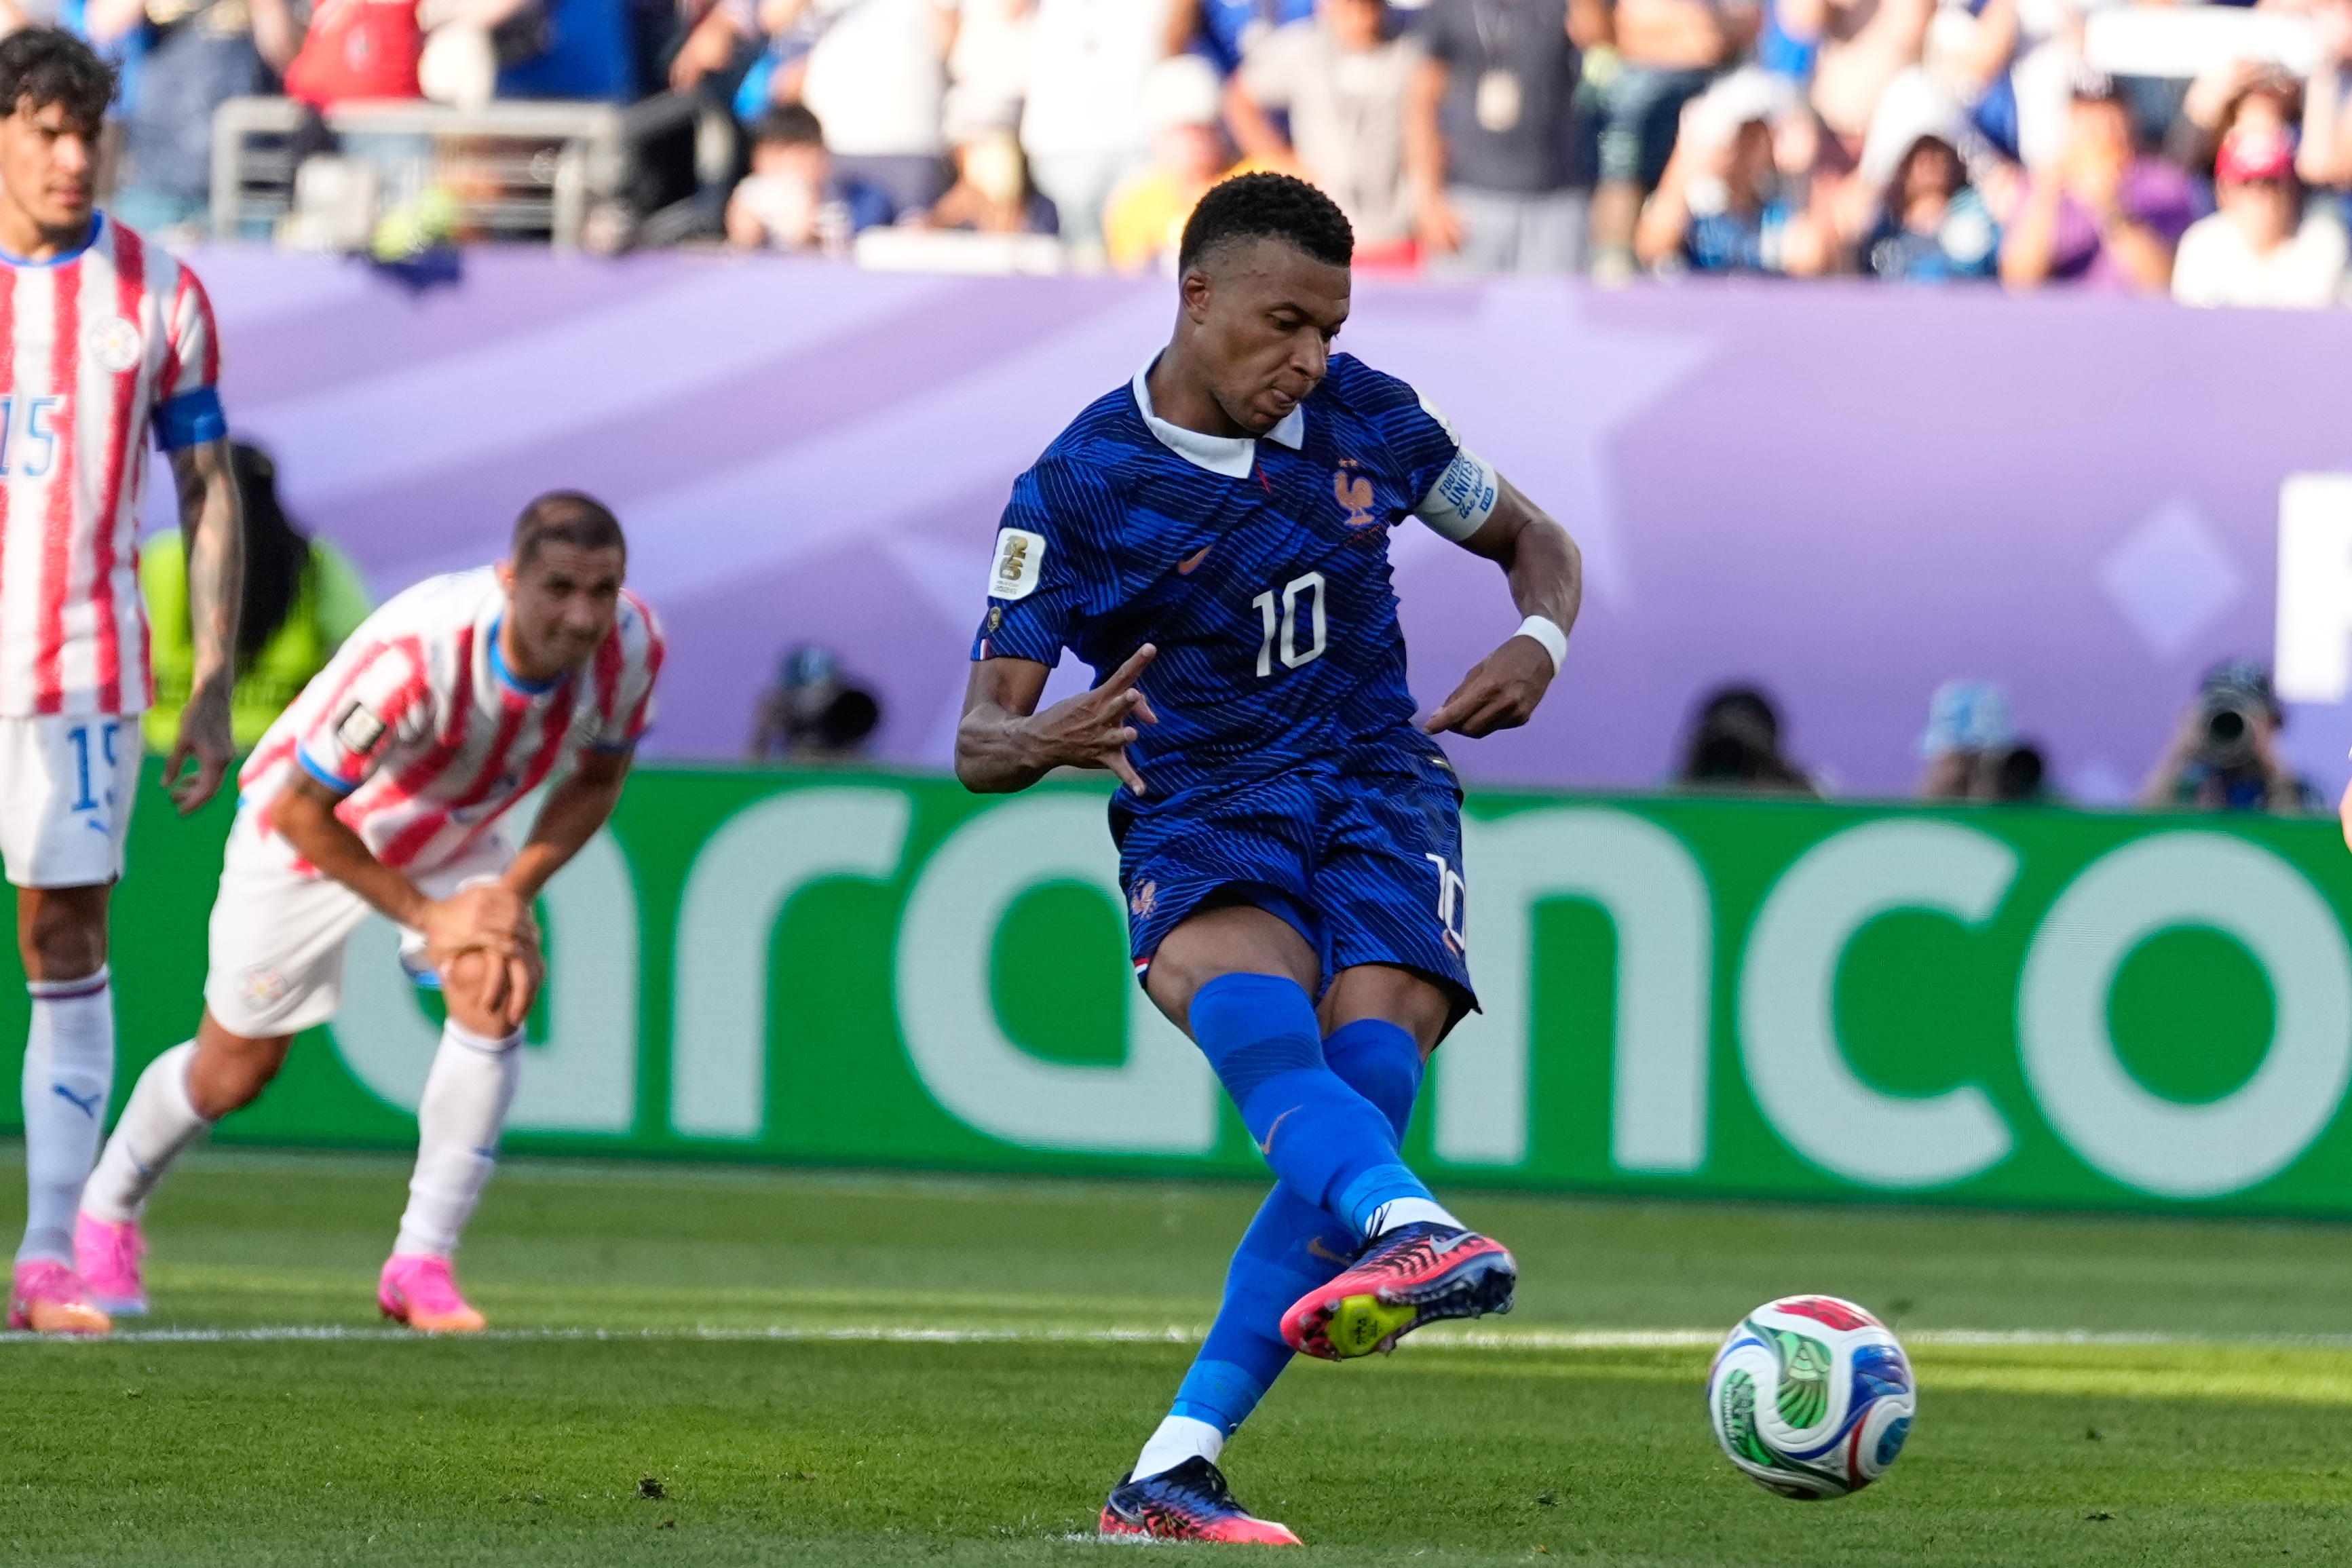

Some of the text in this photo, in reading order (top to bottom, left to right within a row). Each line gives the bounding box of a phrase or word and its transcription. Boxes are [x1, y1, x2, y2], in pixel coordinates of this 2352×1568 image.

[1447, 460, 1473, 505] UNITES
[1252, 571, 1326, 677] 10
[1425, 852, 1466, 950] 10
